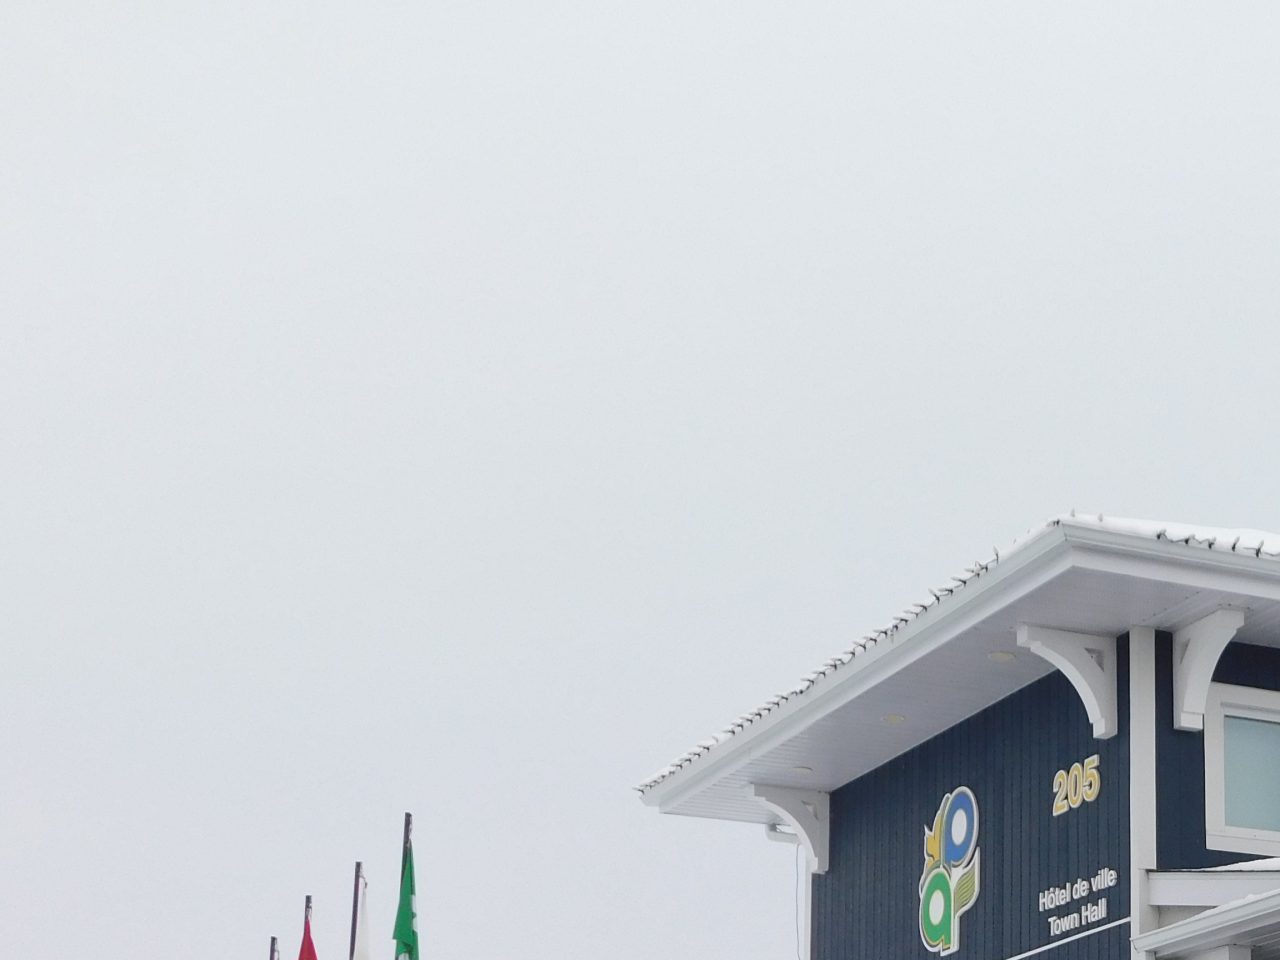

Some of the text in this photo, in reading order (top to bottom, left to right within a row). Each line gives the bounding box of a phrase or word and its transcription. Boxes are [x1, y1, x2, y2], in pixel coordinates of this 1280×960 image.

[1053, 754, 1100, 816] 205
[1039, 867, 1118, 911] Hôtel de ville
[1048, 898, 1107, 936] Town Hall
